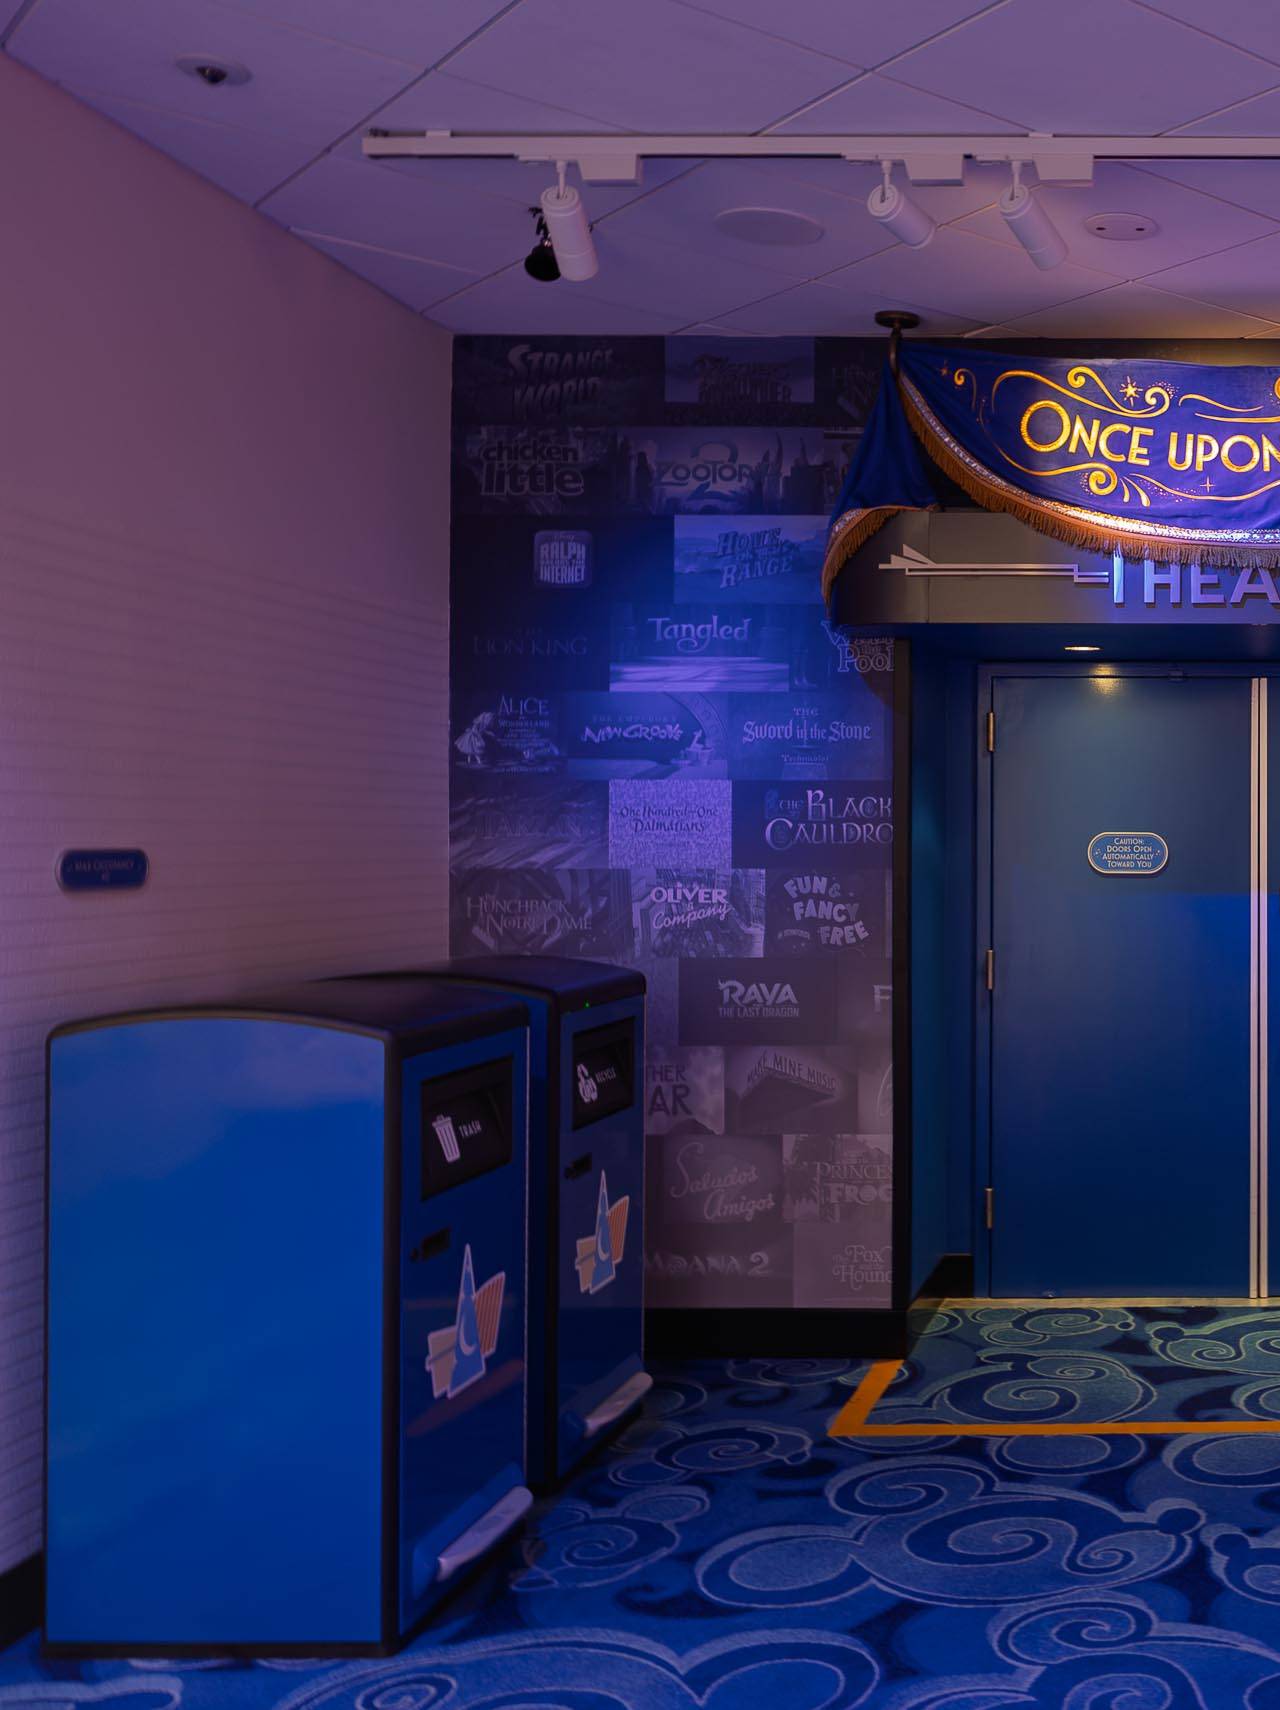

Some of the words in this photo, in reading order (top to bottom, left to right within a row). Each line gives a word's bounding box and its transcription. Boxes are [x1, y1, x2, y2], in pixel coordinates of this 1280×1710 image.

[1020, 398, 1154, 466] ONCE
[480, 438, 580, 463] chicken
[480, 460, 585, 496] little
[540, 541, 586, 560] RALPH
[540, 565, 585, 585] INTERNET
[719, 555, 793, 590] RANGE
[473, 634, 524, 655] LION
[530, 634, 588, 655] KING
[648, 613, 752, 654] Tangled
[498, 695, 550, 716] ALICE
[622, 722, 684, 742] GROOVE
[742, 719, 793, 744] Sword
[828, 719, 873, 743] Stone
[806, 789, 893, 821] BLACK
[634, 819, 706, 833] Dalmatians
[765, 817, 894, 850] CAULDRO
[1106, 845, 1132, 853] DOORS
[1133, 845, 1153, 853] OPEN
[1113, 837, 1144, 845] CAUTION
[1102, 853, 1155, 861] AUTOMATICALLY
[1107, 860, 1135, 868] TOWARD
[783, 874, 829, 900] FUN
[466, 895, 569, 918] HUNCHBACK
[653, 902, 736, 930] Company
[792, 898, 861, 923] FANCY
[543, 912, 593, 936] DAME
[816, 918, 873, 947] FREE
[717, 977, 800, 1006] RAYA
[718, 1006, 735, 1018] THE
[737, 1006, 761, 1018] LAST
[762, 1006, 800, 1018] DRAGON
[594, 1065, 617, 1084] RECYCLE
[772, 1052, 804, 1080] MINE
[807, 1066, 842, 1091] MUSIC
[458, 1119, 482, 1139] TRASH
[670, 1142, 761, 1199] Saludos
[749, 1250, 770, 1277] 2
